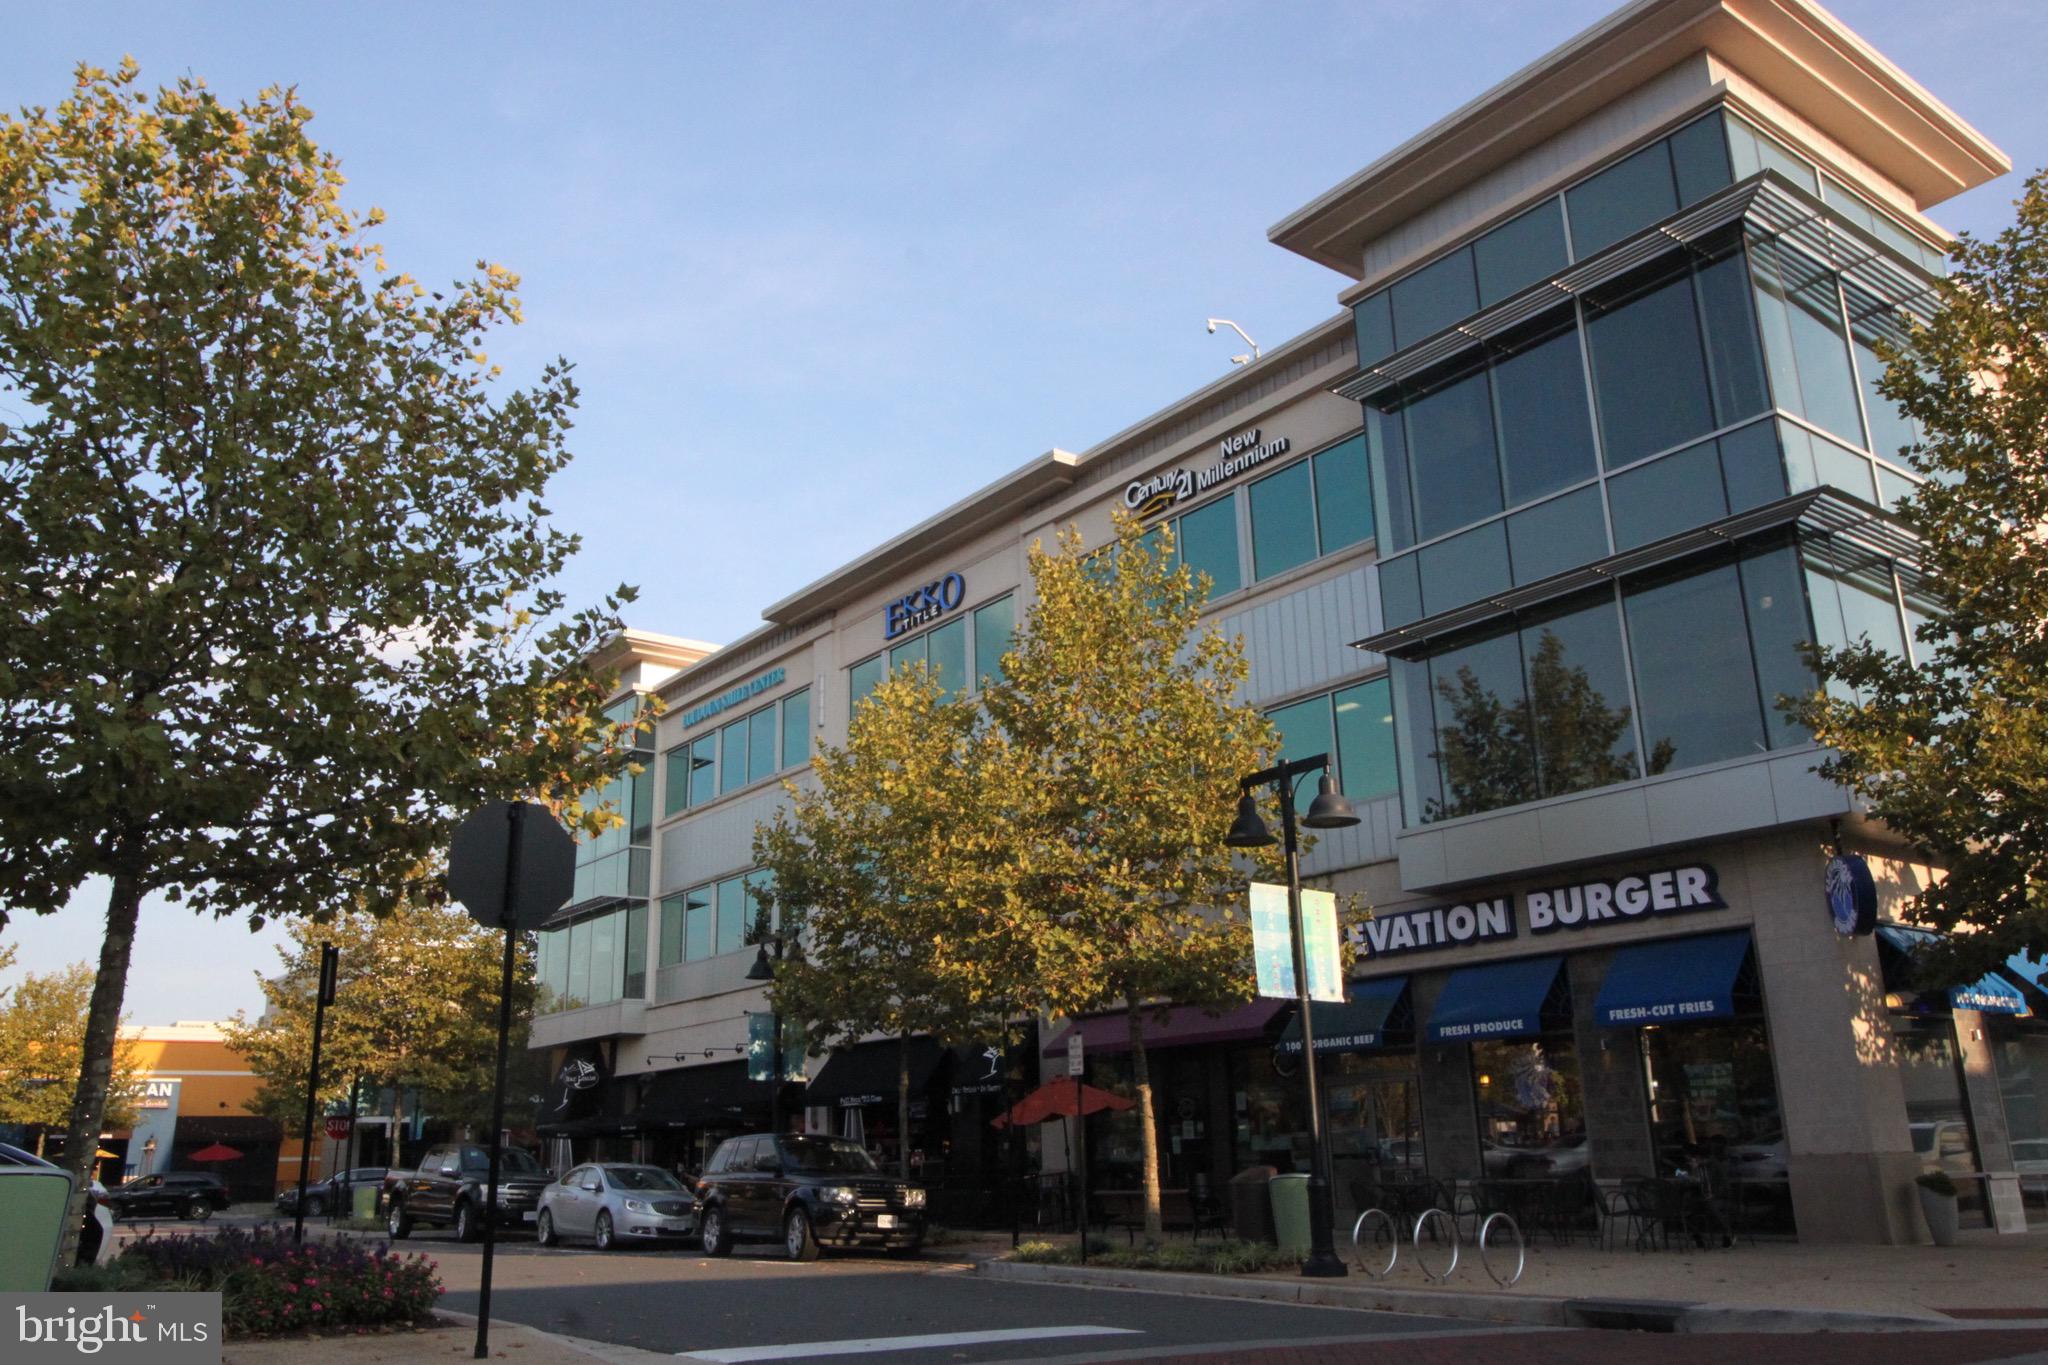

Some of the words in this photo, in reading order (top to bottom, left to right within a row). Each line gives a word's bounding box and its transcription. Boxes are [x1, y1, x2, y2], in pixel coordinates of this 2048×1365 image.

[1220, 429, 1257, 458] New
[1197, 437, 1286, 490] Millennium
[1125, 470, 1180, 508] Century
[1175, 471, 1193, 501] 21
[884, 572, 965, 639] EKKO
[903, 604, 938, 630] TITLE
[1347, 898, 1508, 957] EVATION
[1526, 867, 1714, 930] BURGER
[1609, 1004, 1676, 1020] FRESH-CUT
[1678, 1000, 1715, 1015] FRIES
[1285, 1040, 1304, 1051] 100
[1353, 1034, 1375, 1046] BEEF
[1440, 1024, 1471, 1037] FRESH
[1473, 1019, 1524, 1034] PRODUCE
